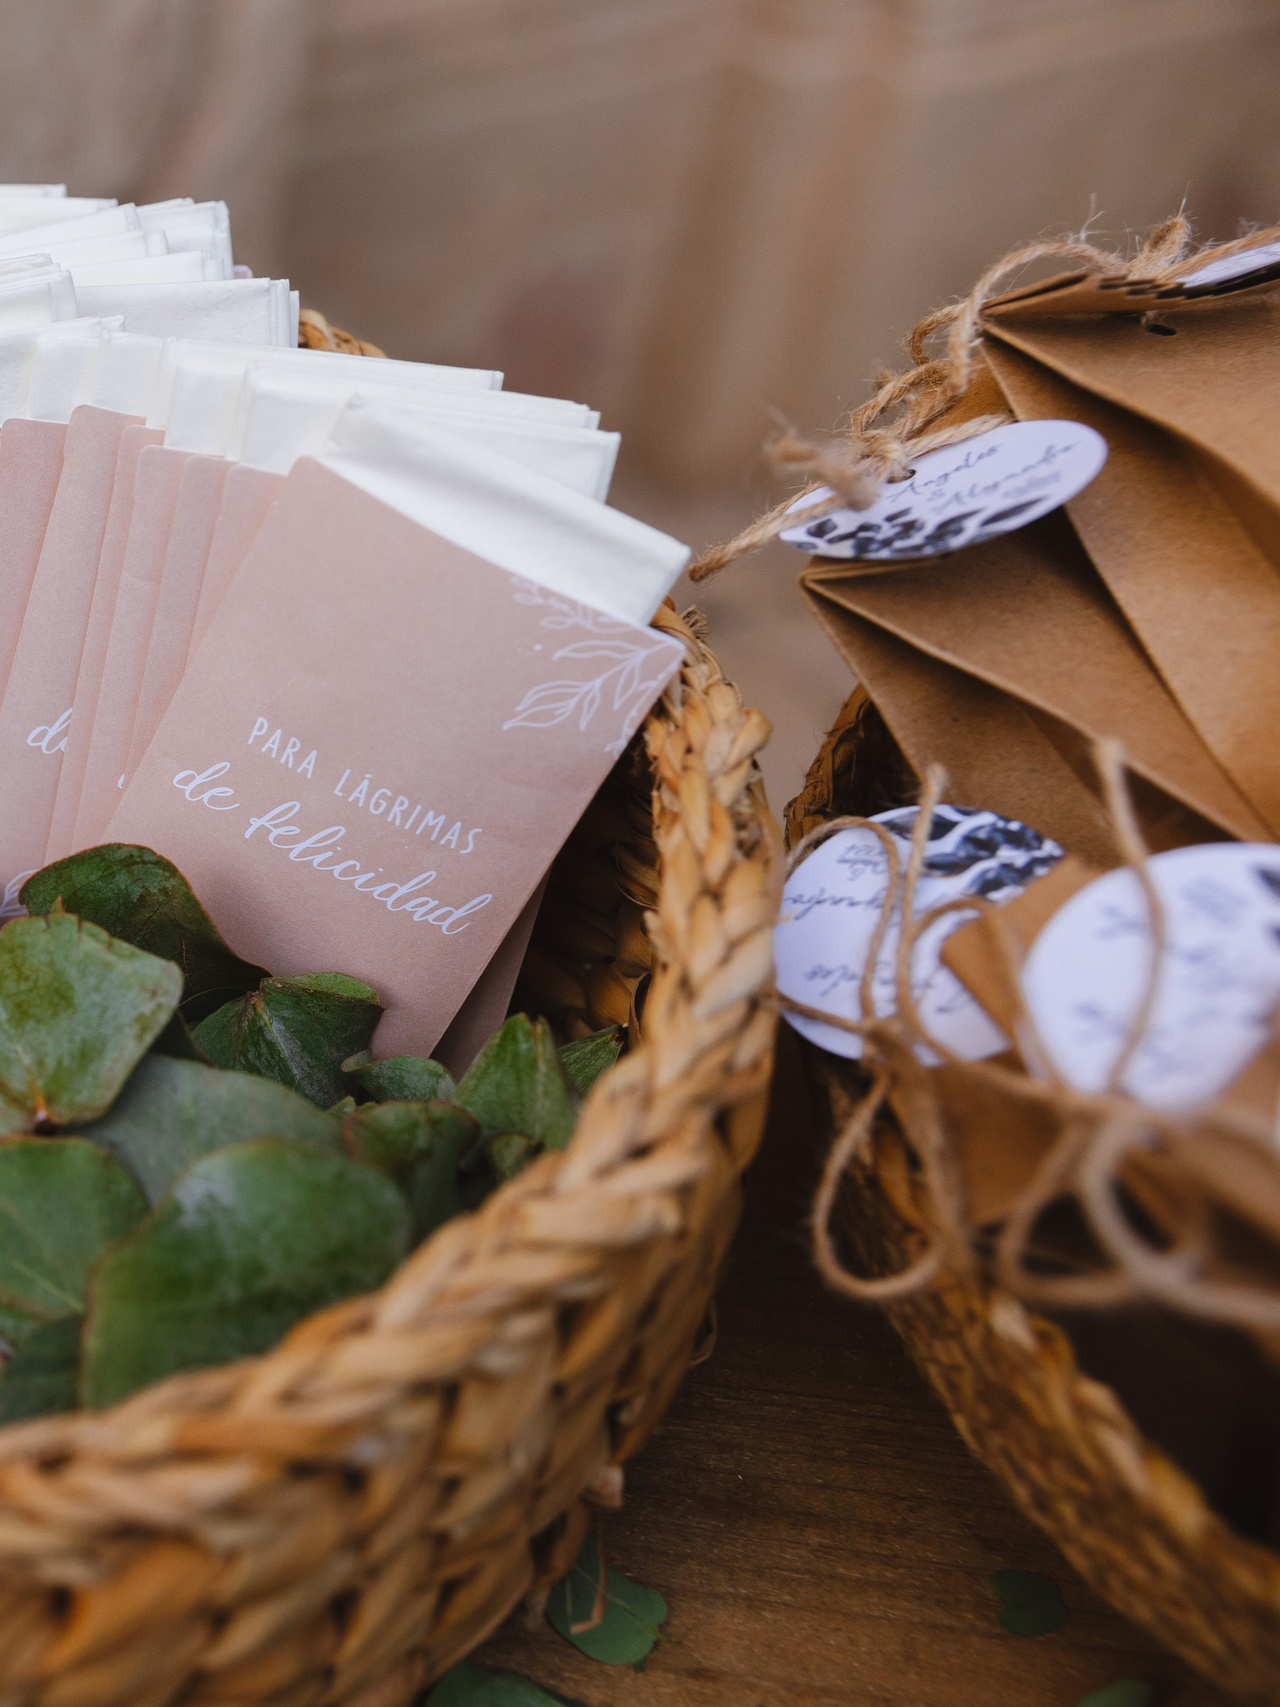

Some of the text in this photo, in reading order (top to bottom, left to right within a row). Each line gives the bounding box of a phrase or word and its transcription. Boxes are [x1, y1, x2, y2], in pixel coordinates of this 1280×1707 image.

[172, 761, 493, 935] de felicidad
[247, 716, 482, 854] PARA LÁGRIMAS
